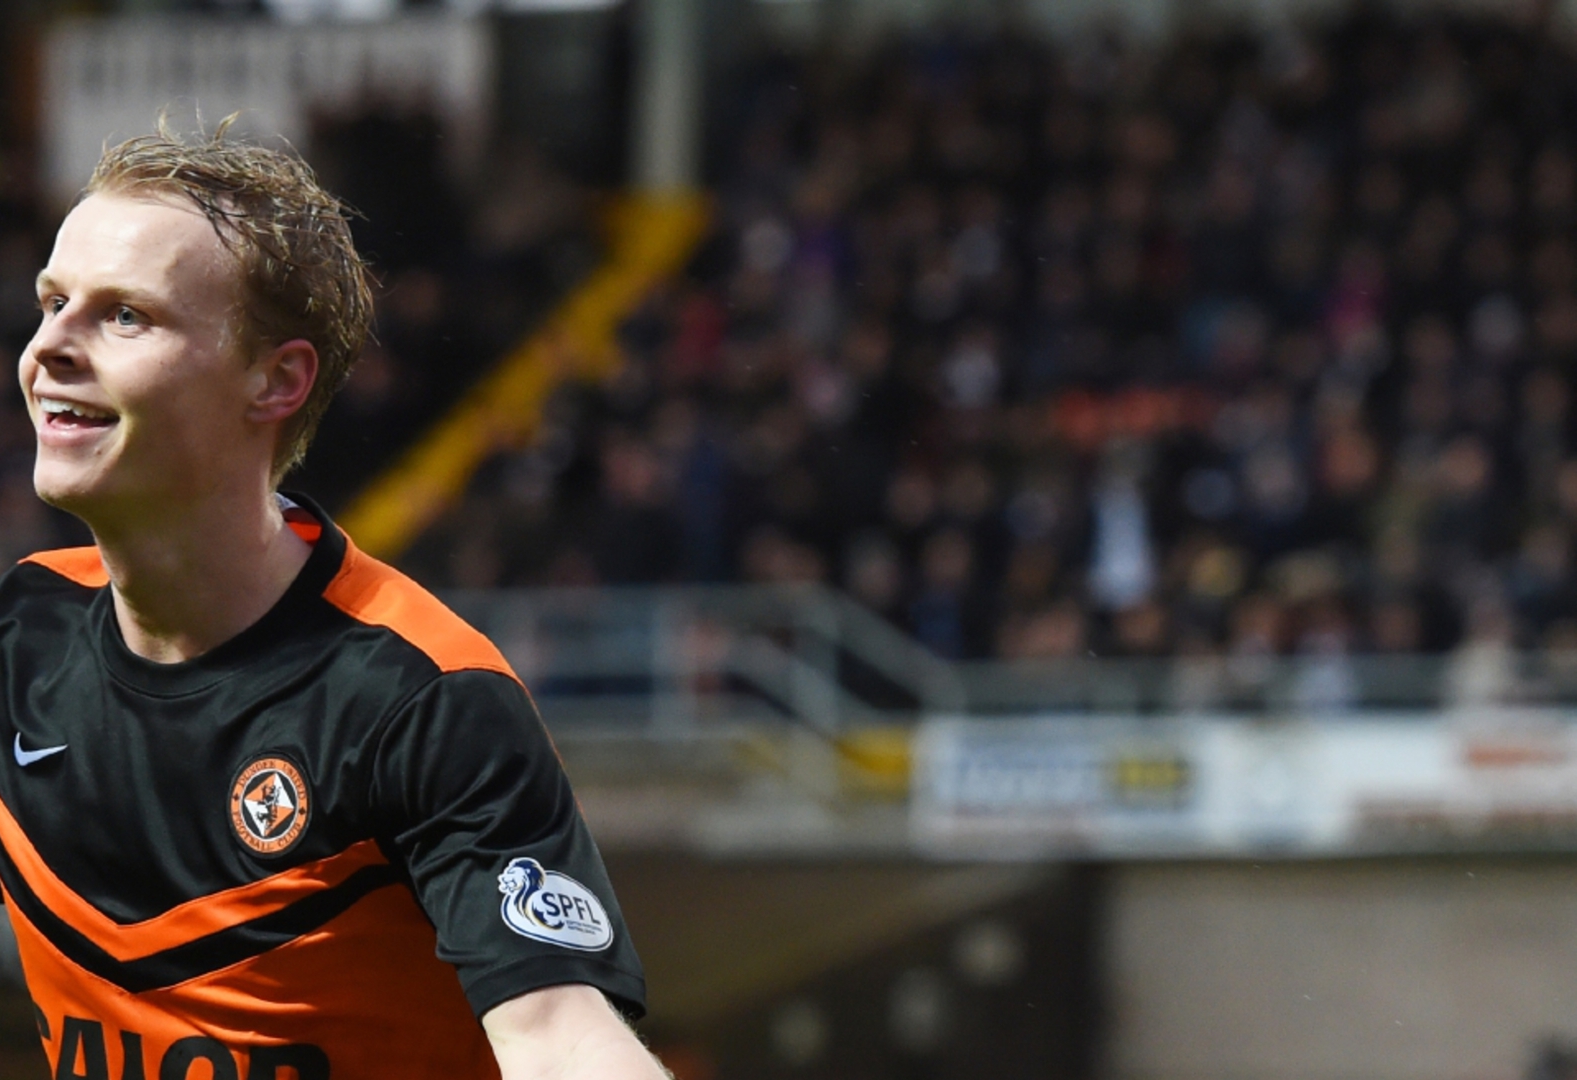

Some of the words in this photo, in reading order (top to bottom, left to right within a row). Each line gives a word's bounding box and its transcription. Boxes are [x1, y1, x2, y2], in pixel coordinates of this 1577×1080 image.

[238, 760, 276, 786] DUNDEE
[283, 763, 306, 799] UNITED
[541, 891, 601, 925] SPFL
